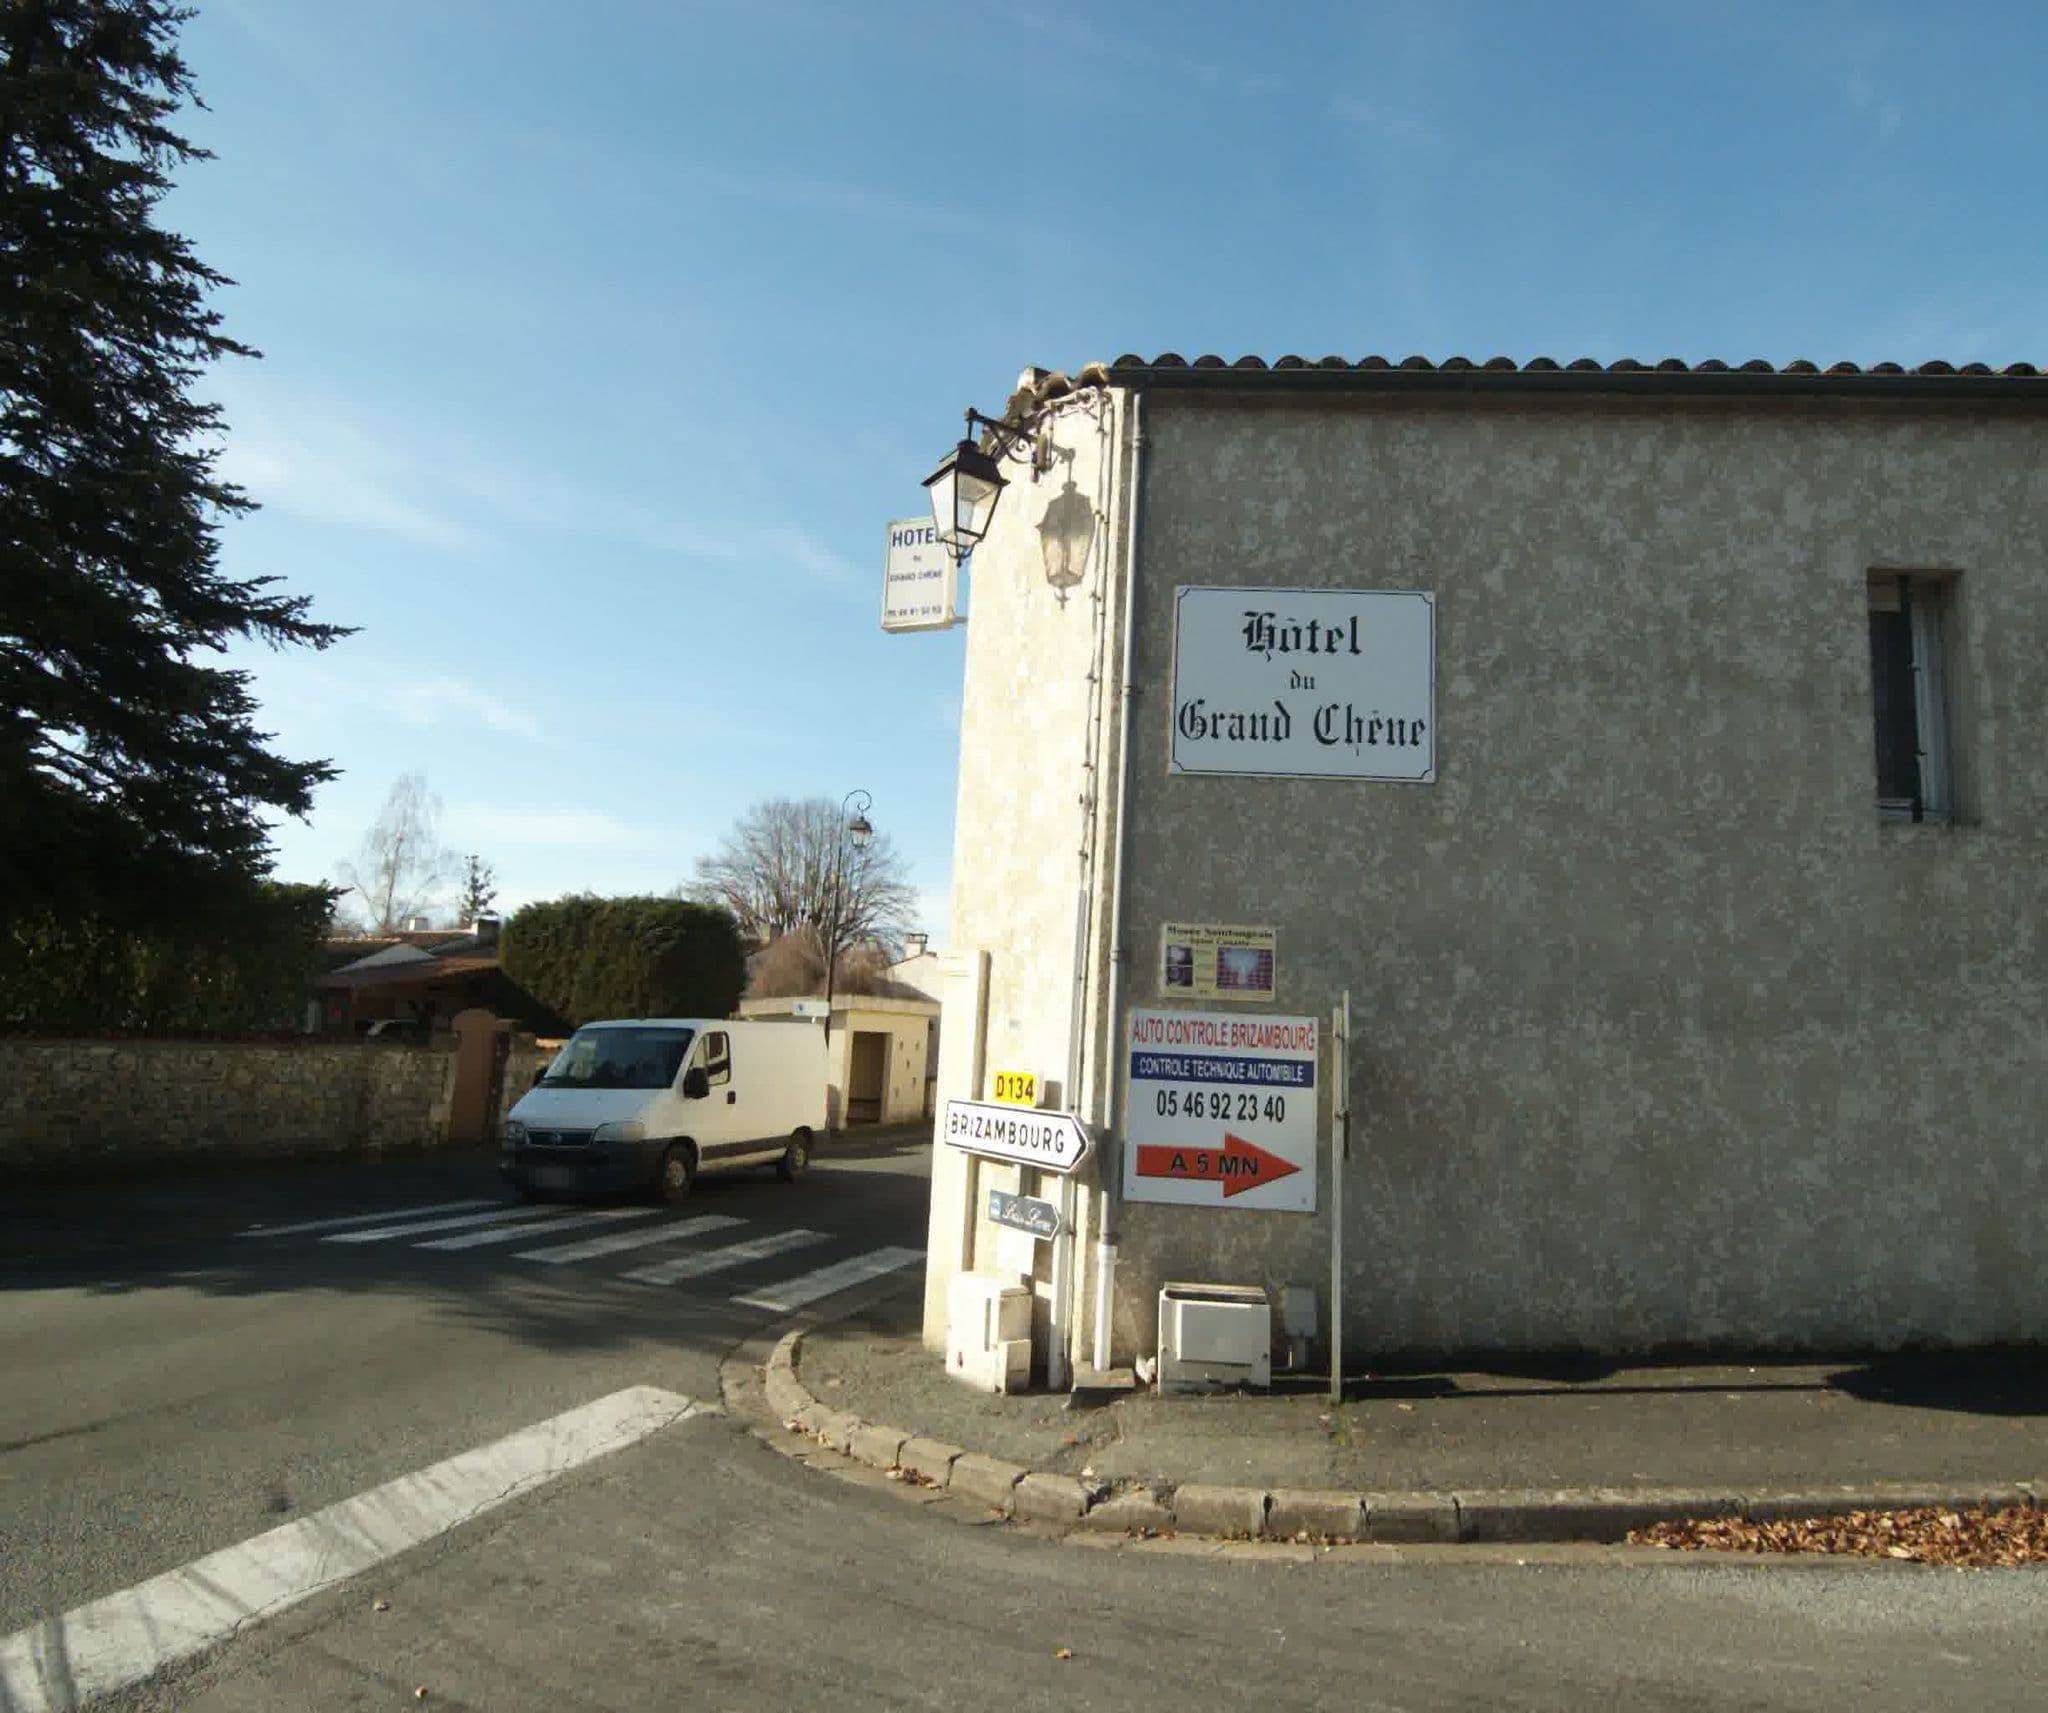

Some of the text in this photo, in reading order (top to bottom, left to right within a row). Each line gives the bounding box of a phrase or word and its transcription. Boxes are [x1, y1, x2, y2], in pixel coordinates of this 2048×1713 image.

[892, 527, 936, 547] HOTE
[1289, 669, 1316, 690] du
[1178, 699, 1291, 742] Grand
[1133, 1017, 1315, 1051] AUTO CONTROLE BRIZAMBOURG
[1139, 1059, 1190, 1076] CONTROLE
[1192, 1060, 1245, 1079] TECHNIQUE
[1156, 1089, 1285, 1122] 05 46 92 23 40
[951, 1113, 1065, 1153] BRIZAMBOURG
[1170, 1152, 1258, 1177] A 5 MN
